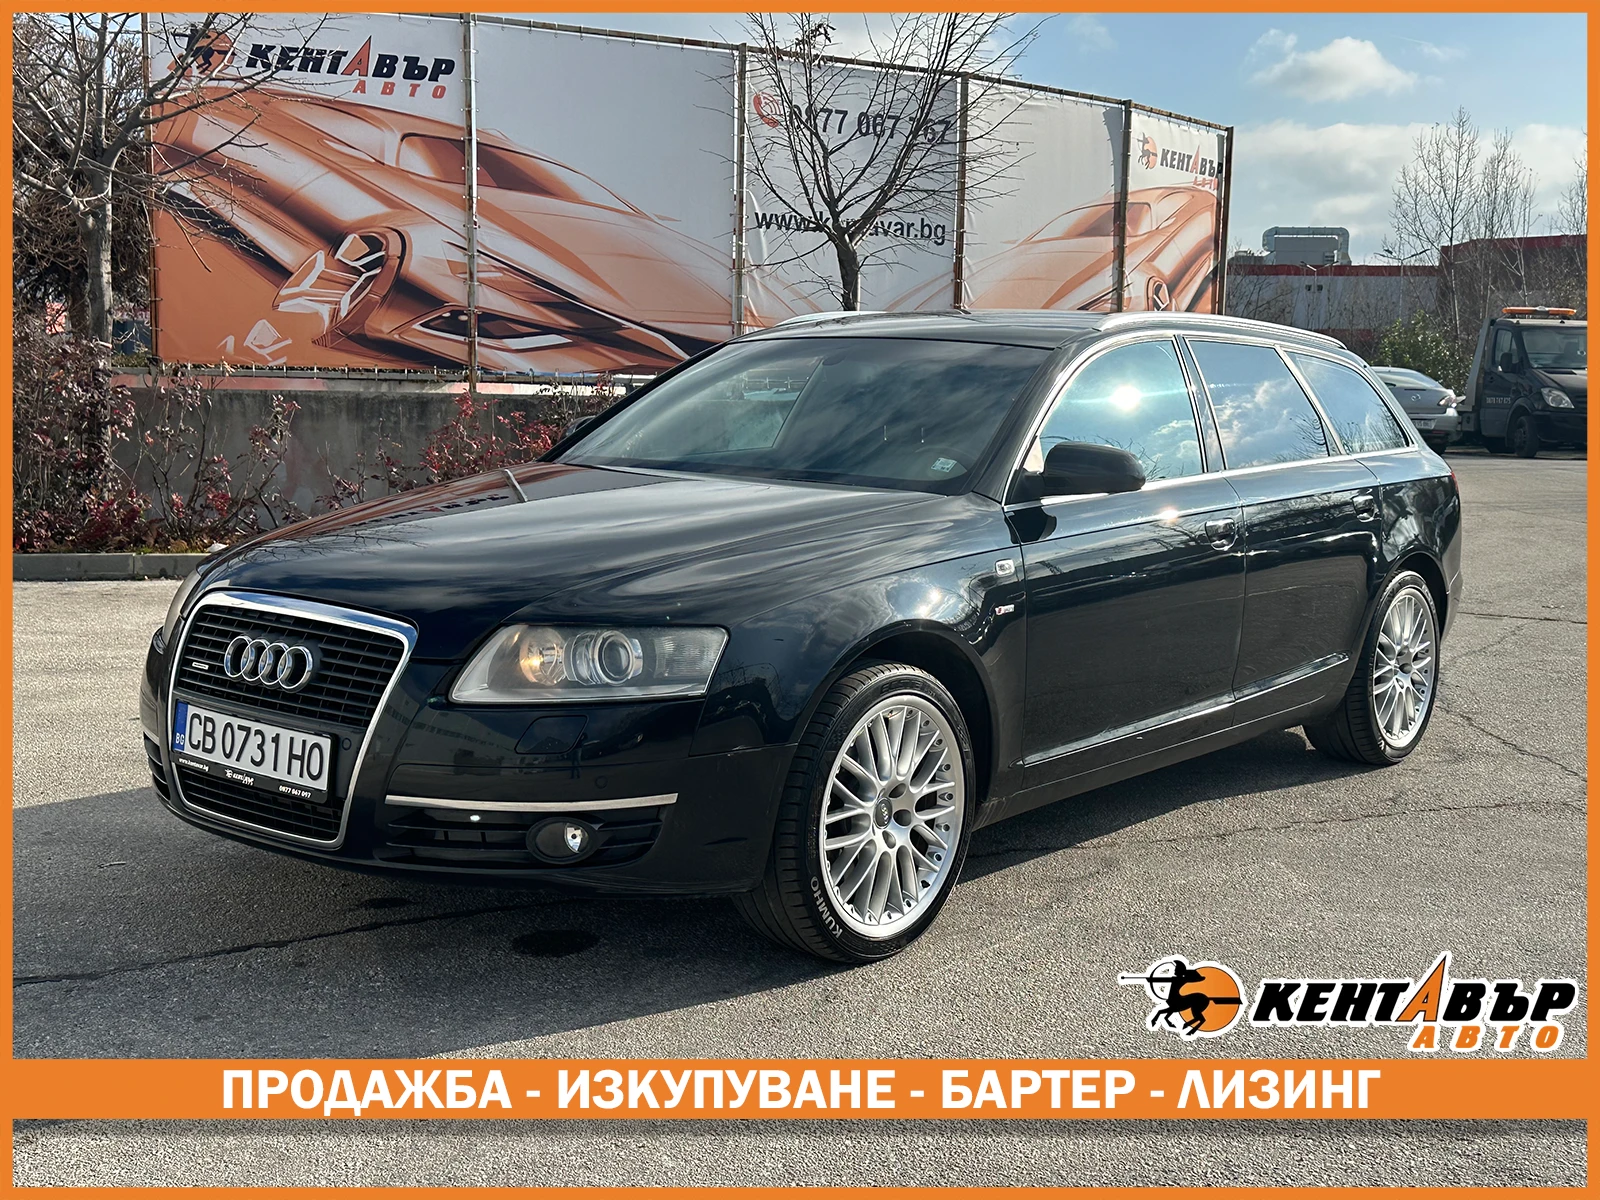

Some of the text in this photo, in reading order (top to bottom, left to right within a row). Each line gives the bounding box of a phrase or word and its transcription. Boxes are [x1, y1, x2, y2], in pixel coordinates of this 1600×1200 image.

[246, 36, 455, 82] КЕНТАВЪР
[352, 80, 447, 99] АВТО
[175, 732, 185, 746] BG
[188, 713, 216, 754] CB
[221, 722, 281, 772] 0731
[811, 876, 842, 938] KUMHO
